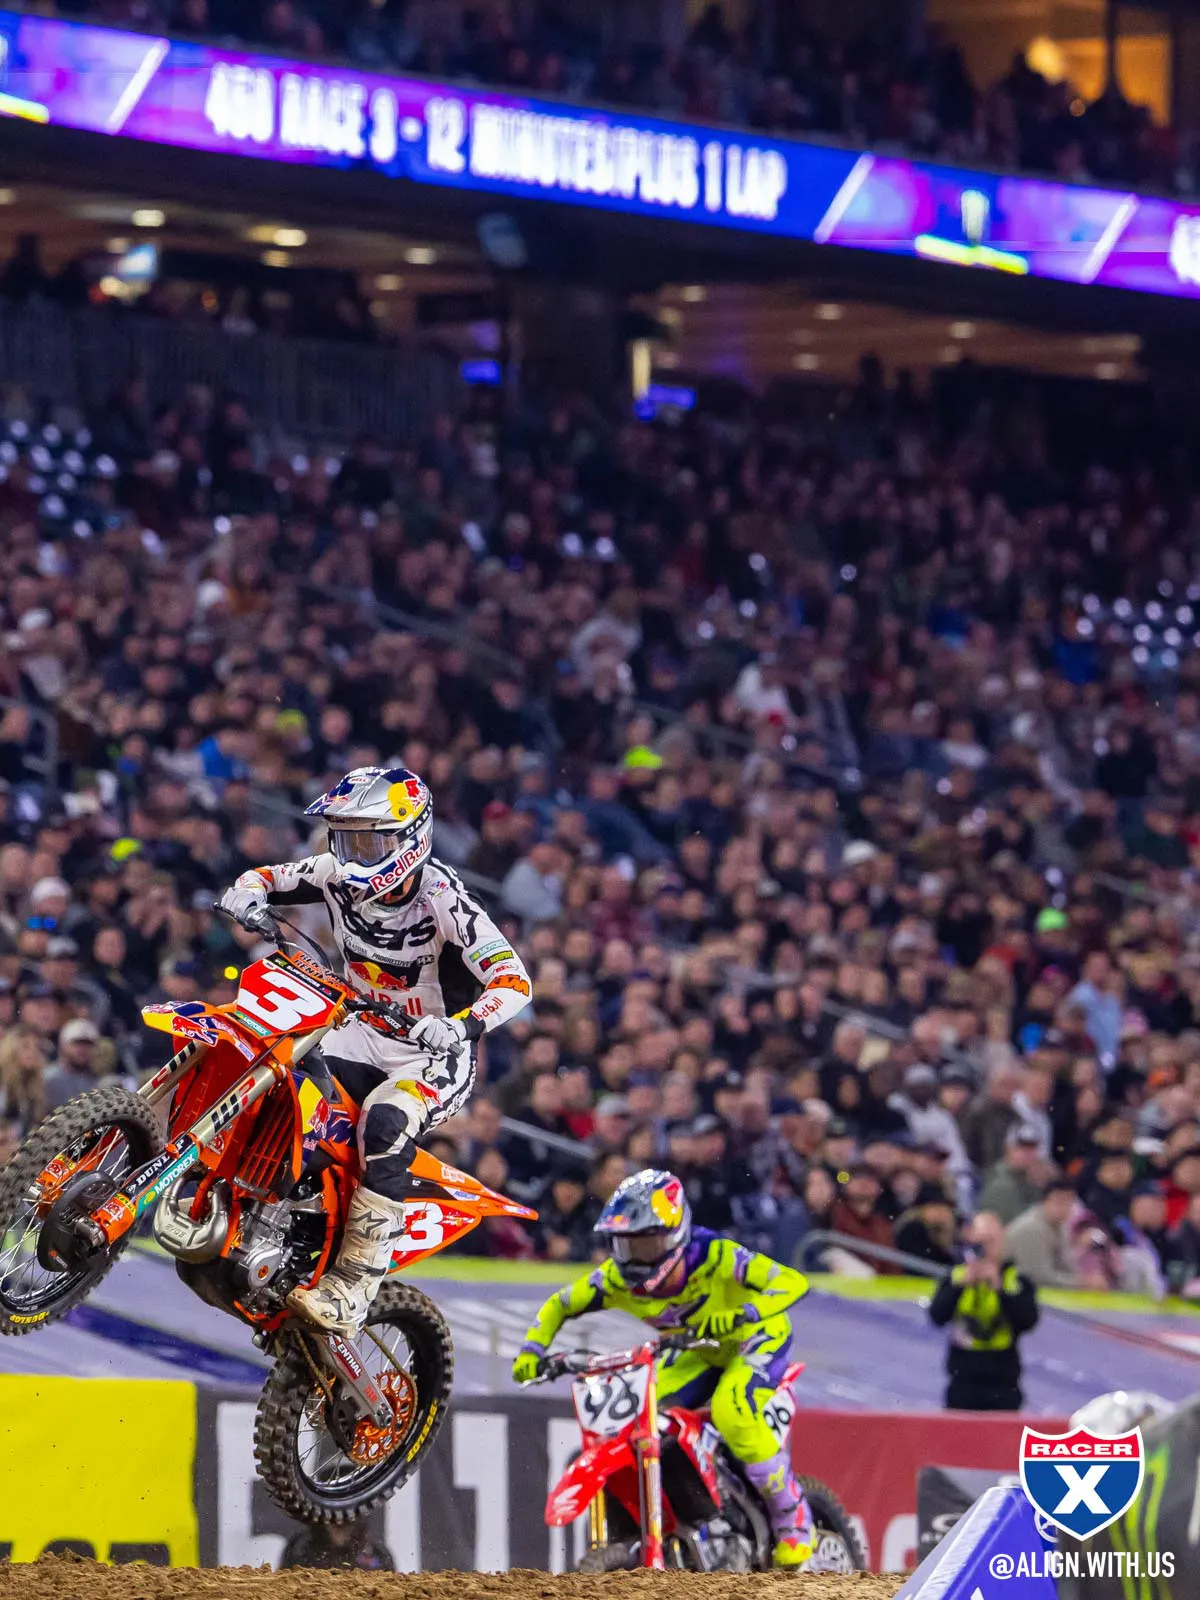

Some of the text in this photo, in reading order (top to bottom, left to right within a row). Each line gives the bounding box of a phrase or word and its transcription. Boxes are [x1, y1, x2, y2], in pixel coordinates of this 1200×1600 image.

[369, 833, 429, 893] Red Bull
[238, 971, 328, 1031] 3
[136, 1139, 185, 1185] DUNLP
[154, 1153, 196, 1195] MOTOREX
[395, 1202, 444, 1252] 3
